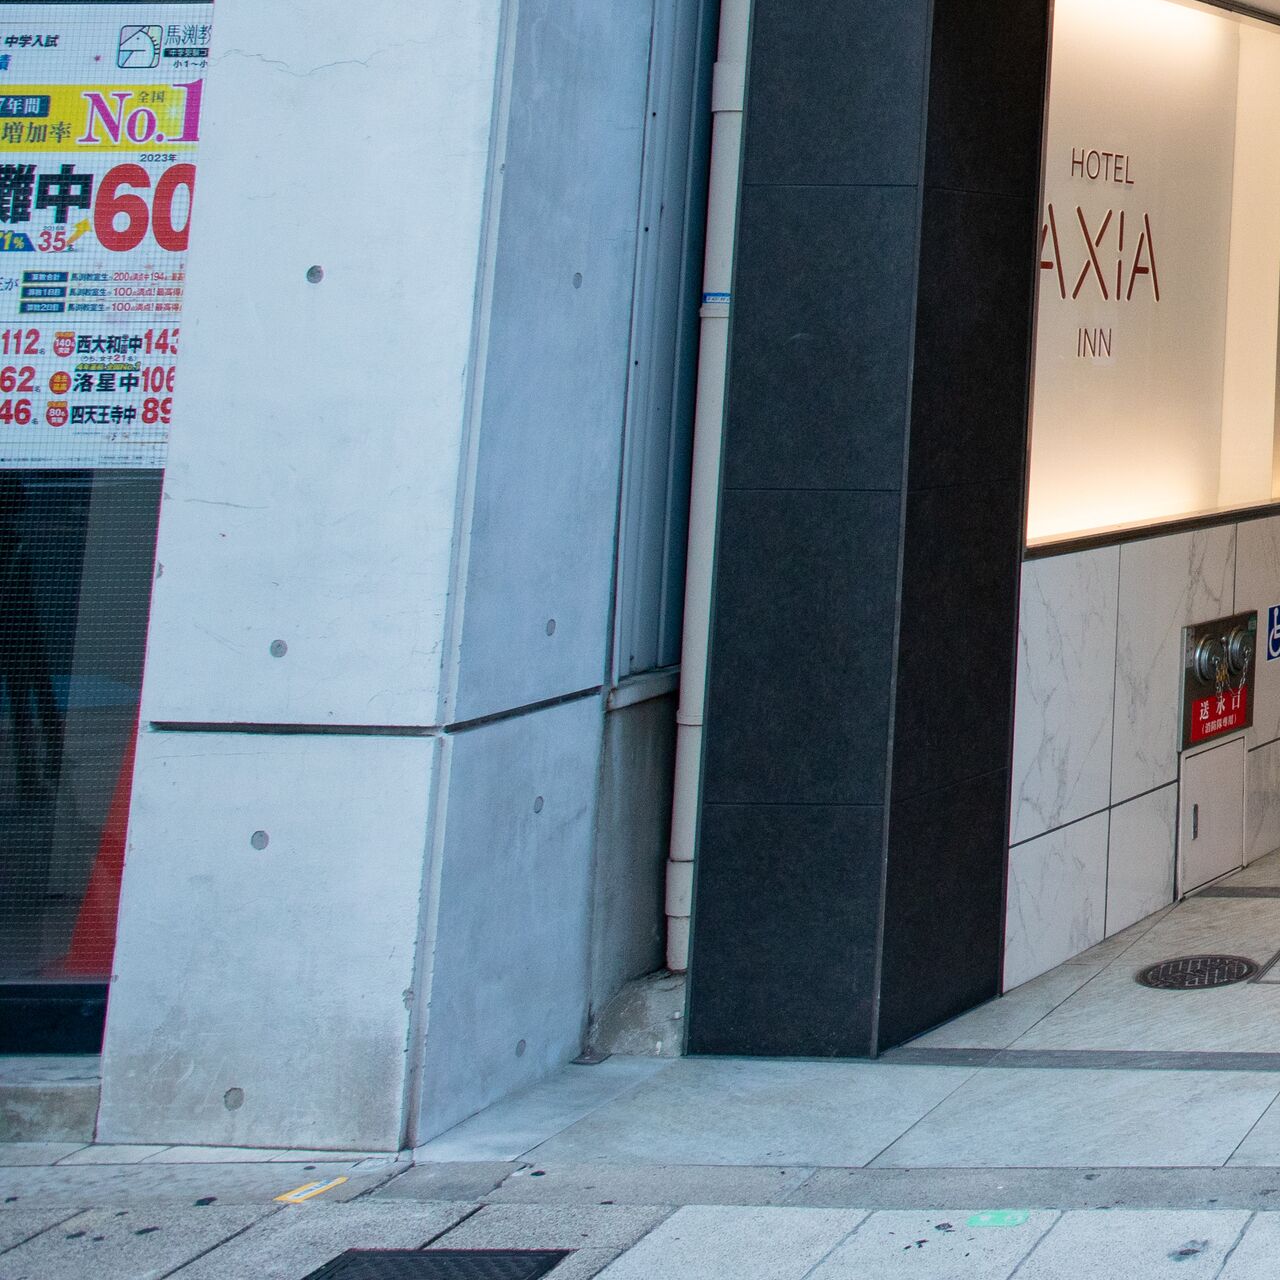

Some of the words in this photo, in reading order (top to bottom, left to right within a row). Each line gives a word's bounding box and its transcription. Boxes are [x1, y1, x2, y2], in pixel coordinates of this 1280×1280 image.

[4, 34, 60, 48] 中学入試
[138, 90, 166, 104] 全国
[78, 78, 204, 143] No.1
[1, 121, 72, 144] 増加率
[140, 153, 177, 163] 2023年
[1071, 147, 1135, 185] HOTEL
[1040, 203, 1160, 302] AXIA
[1077, 327, 1113, 358] INN
[73, 373, 140, 393] 洛星中
[71, 404, 137, 425] 四天王寺中
[1199, 693, 1241, 721] 送水口
